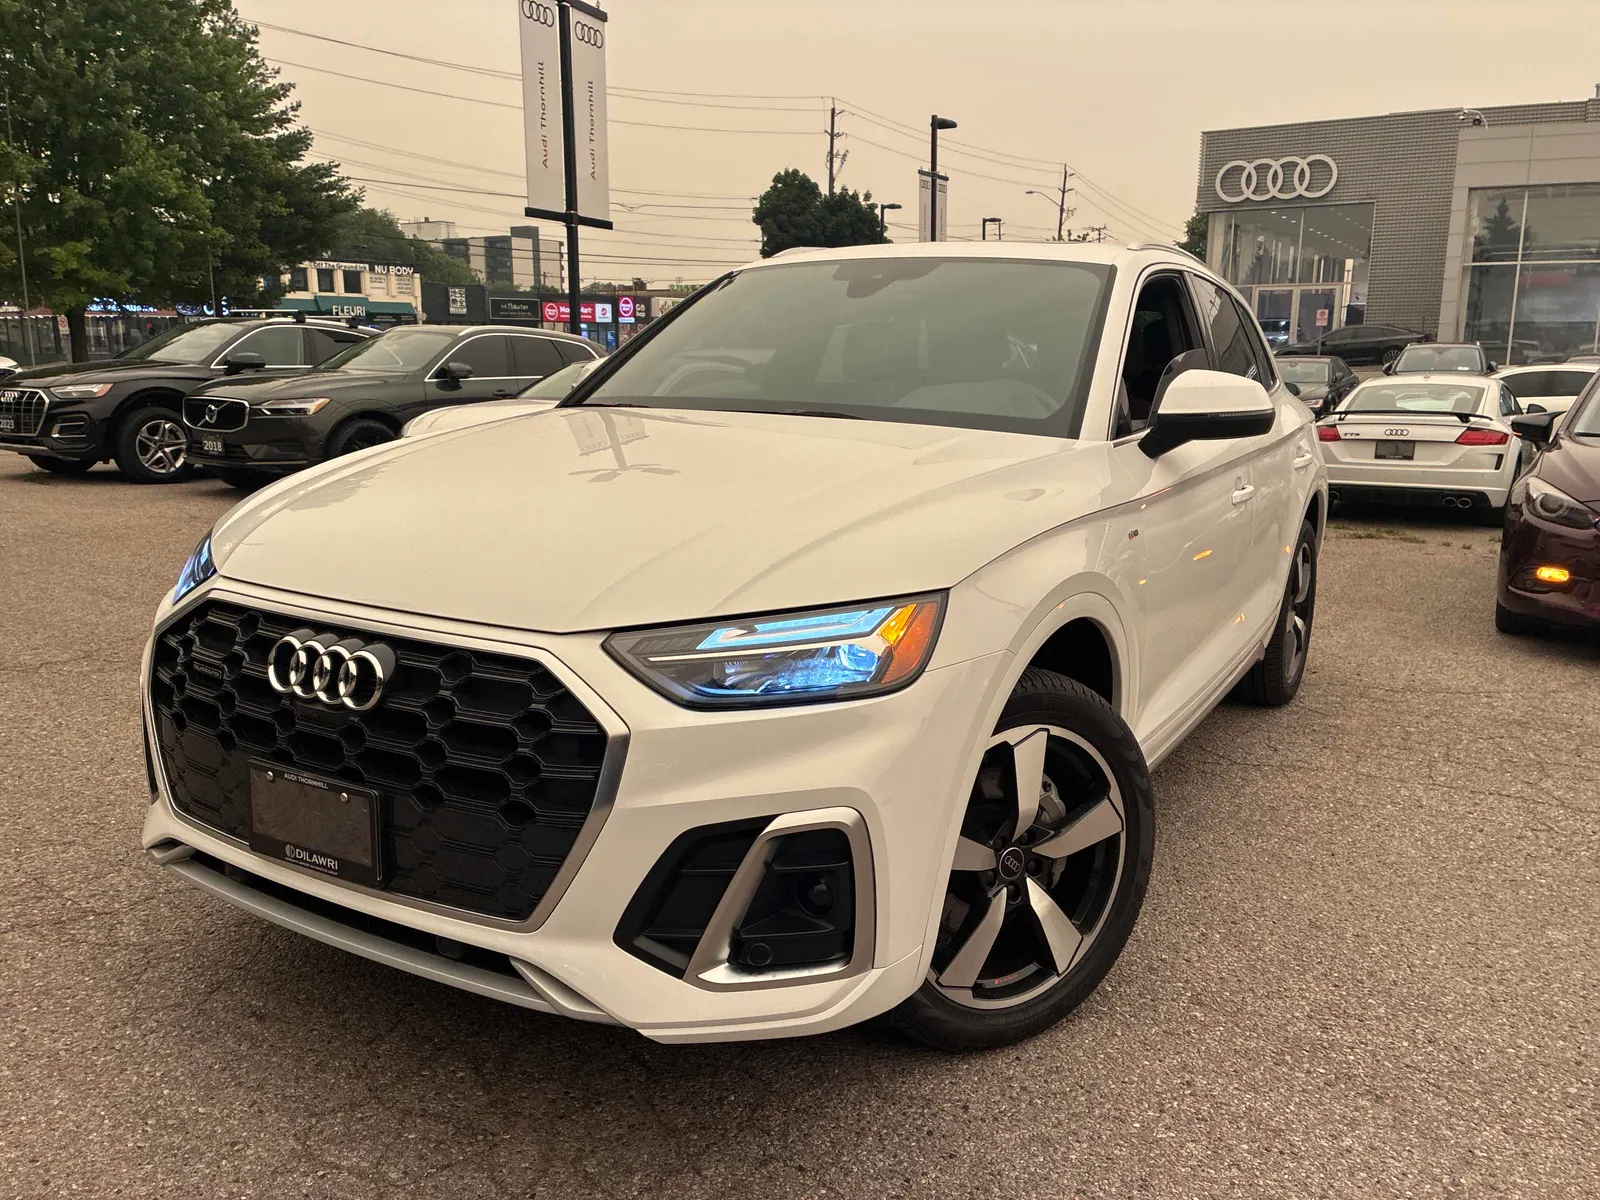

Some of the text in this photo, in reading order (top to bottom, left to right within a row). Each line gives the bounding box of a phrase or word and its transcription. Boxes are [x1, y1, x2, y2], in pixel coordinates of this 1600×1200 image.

[538, 61, 549, 169] Audi Thornhill
[587, 80, 595, 145] Thornhill
[374, 264, 414, 276] NU BODY
[332, 305, 366, 316] FLEURI
[203, 440, 223, 451] 2018
[284, 772, 329, 789] AUDI THORNHILL
[295, 848, 338, 870] DILAWRI
